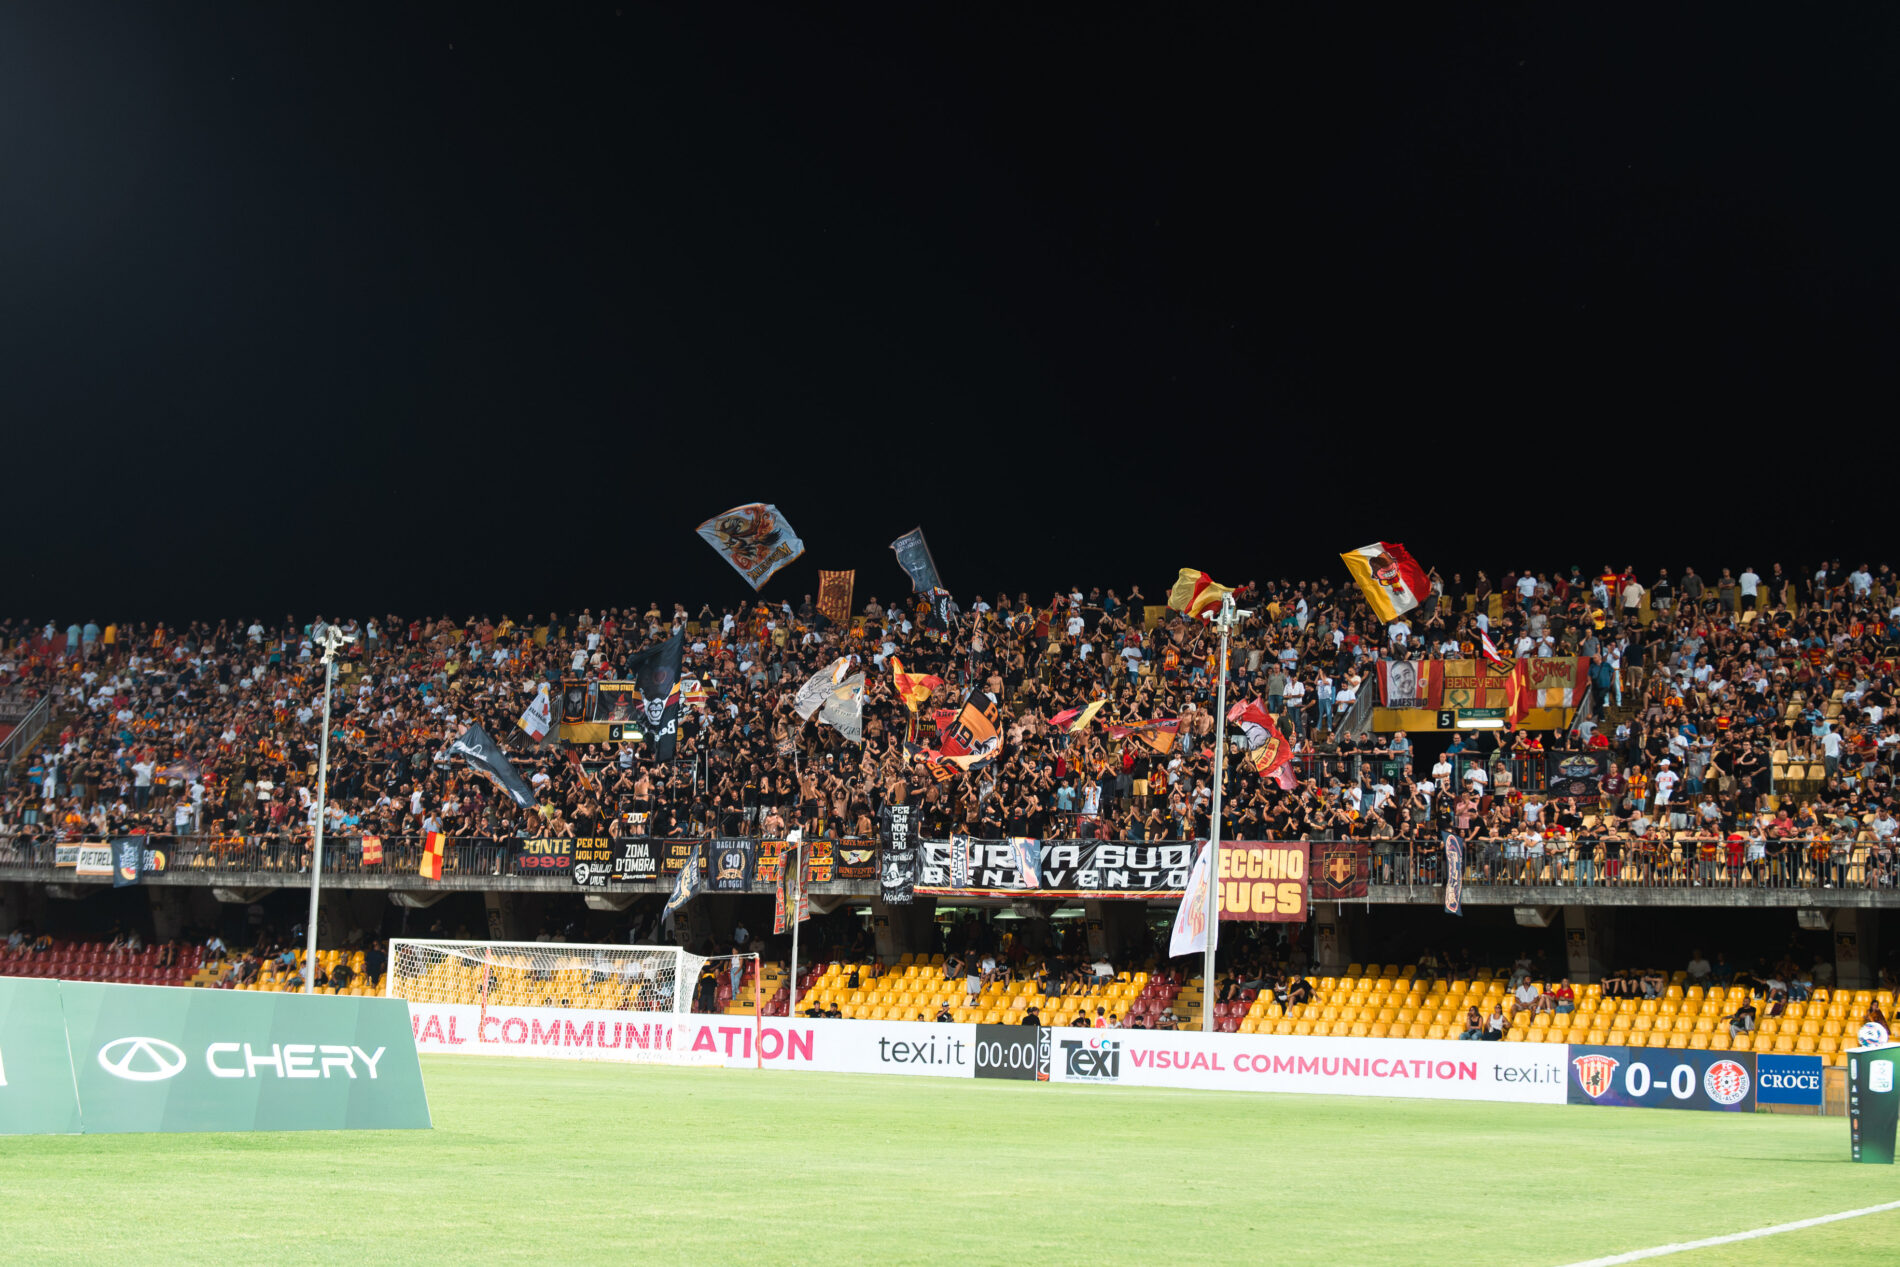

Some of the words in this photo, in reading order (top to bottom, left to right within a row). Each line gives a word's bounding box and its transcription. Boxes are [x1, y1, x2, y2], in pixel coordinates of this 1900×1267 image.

[1446, 678, 1507, 689] BENEVENT
[1441, 714, 1450, 725] 5
[612, 728, 619, 738] 6
[892, 806, 909, 814] PER
[893, 814, 906, 823] CHI
[891, 823, 908, 832] NON
[576, 838, 592, 848] PER
[595, 838, 608, 848] CHI
[625, 844, 649, 858] ZONA
[1096, 845, 1191, 868] SUD
[520, 856, 570, 867] 1998
[615, 858, 655, 872] D'OMBRA
[725, 853, 740, 868] 90
[1219, 849, 1303, 880] ECCHIO
[879, 1035, 966, 1065] texi.it
[976, 1041, 1035, 1070] 00:00
[206, 1042, 387, 1079] CHERY
[1130, 1049, 1225, 1071] VISUAL
[1233, 1053, 1477, 1081] COMMUNICATION
[1493, 1063, 1562, 1084] texi.it
[1760, 1074, 1820, 1090] CROCE
